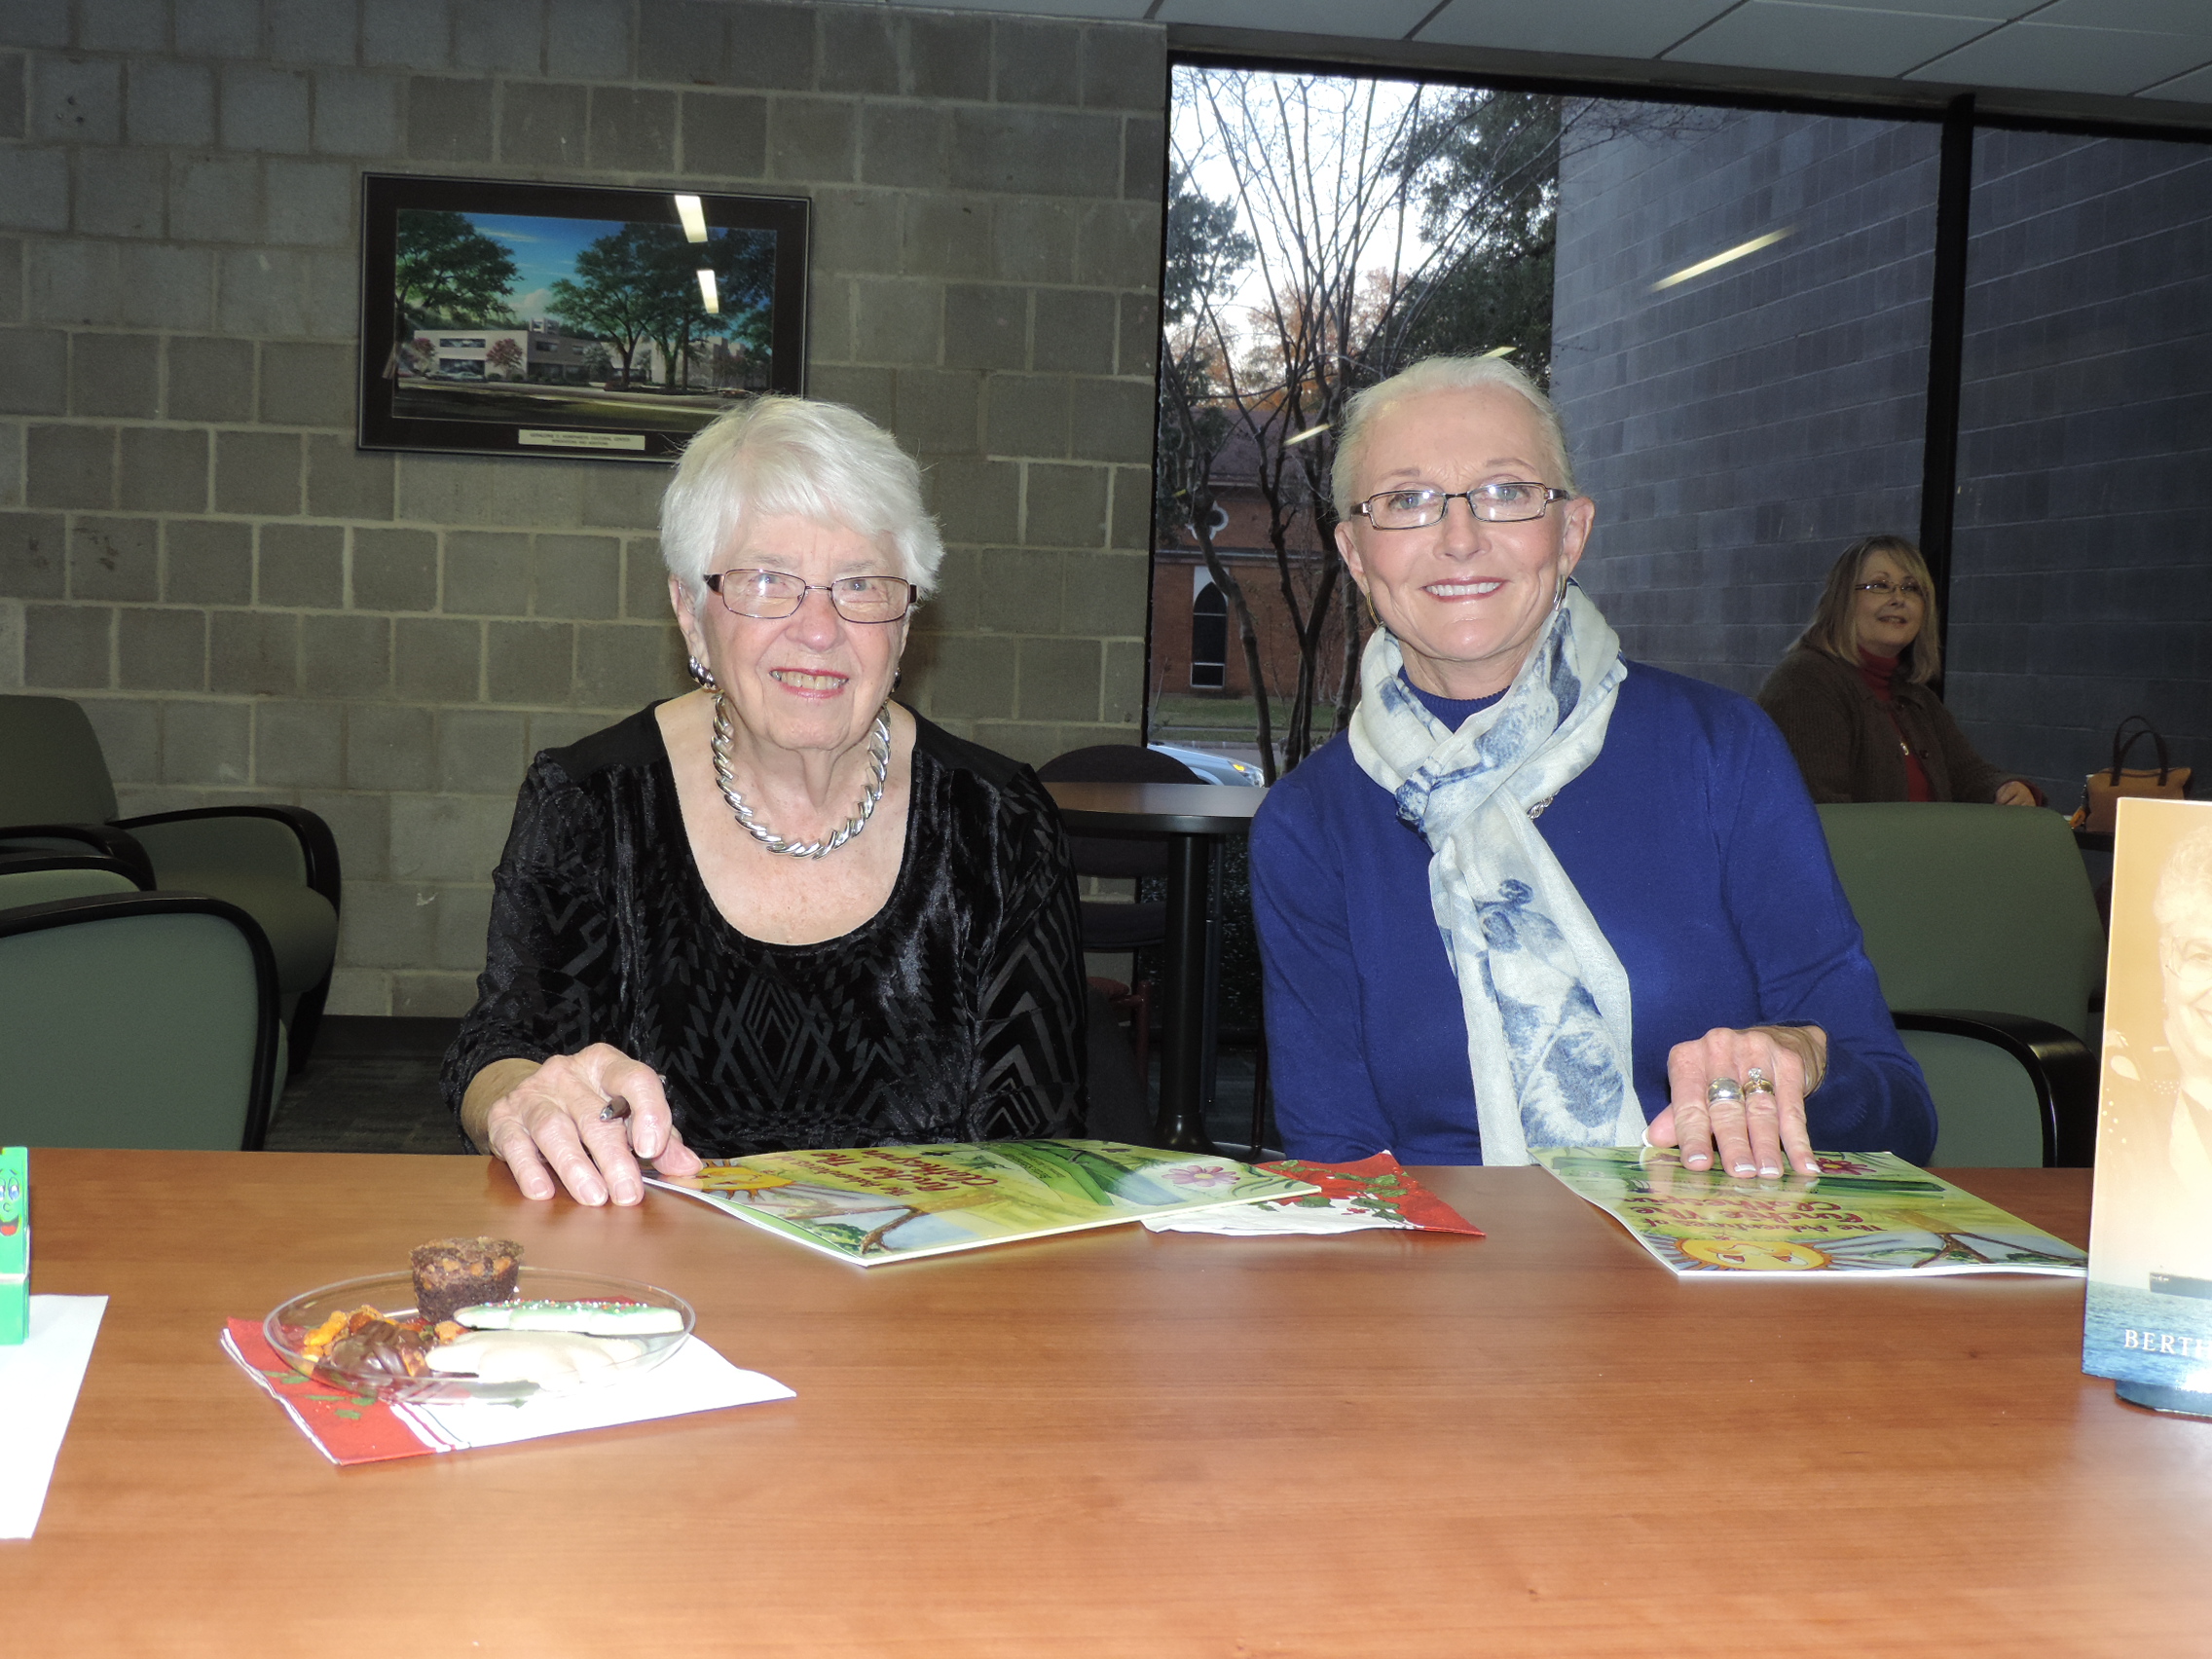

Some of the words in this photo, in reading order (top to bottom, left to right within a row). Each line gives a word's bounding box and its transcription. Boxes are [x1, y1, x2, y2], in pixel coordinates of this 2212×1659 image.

[861, 1150, 999, 1186] Clothespin
[1618, 1195, 1842, 1212] Clothespin
[1674, 1219, 1830, 1234] Adventures
